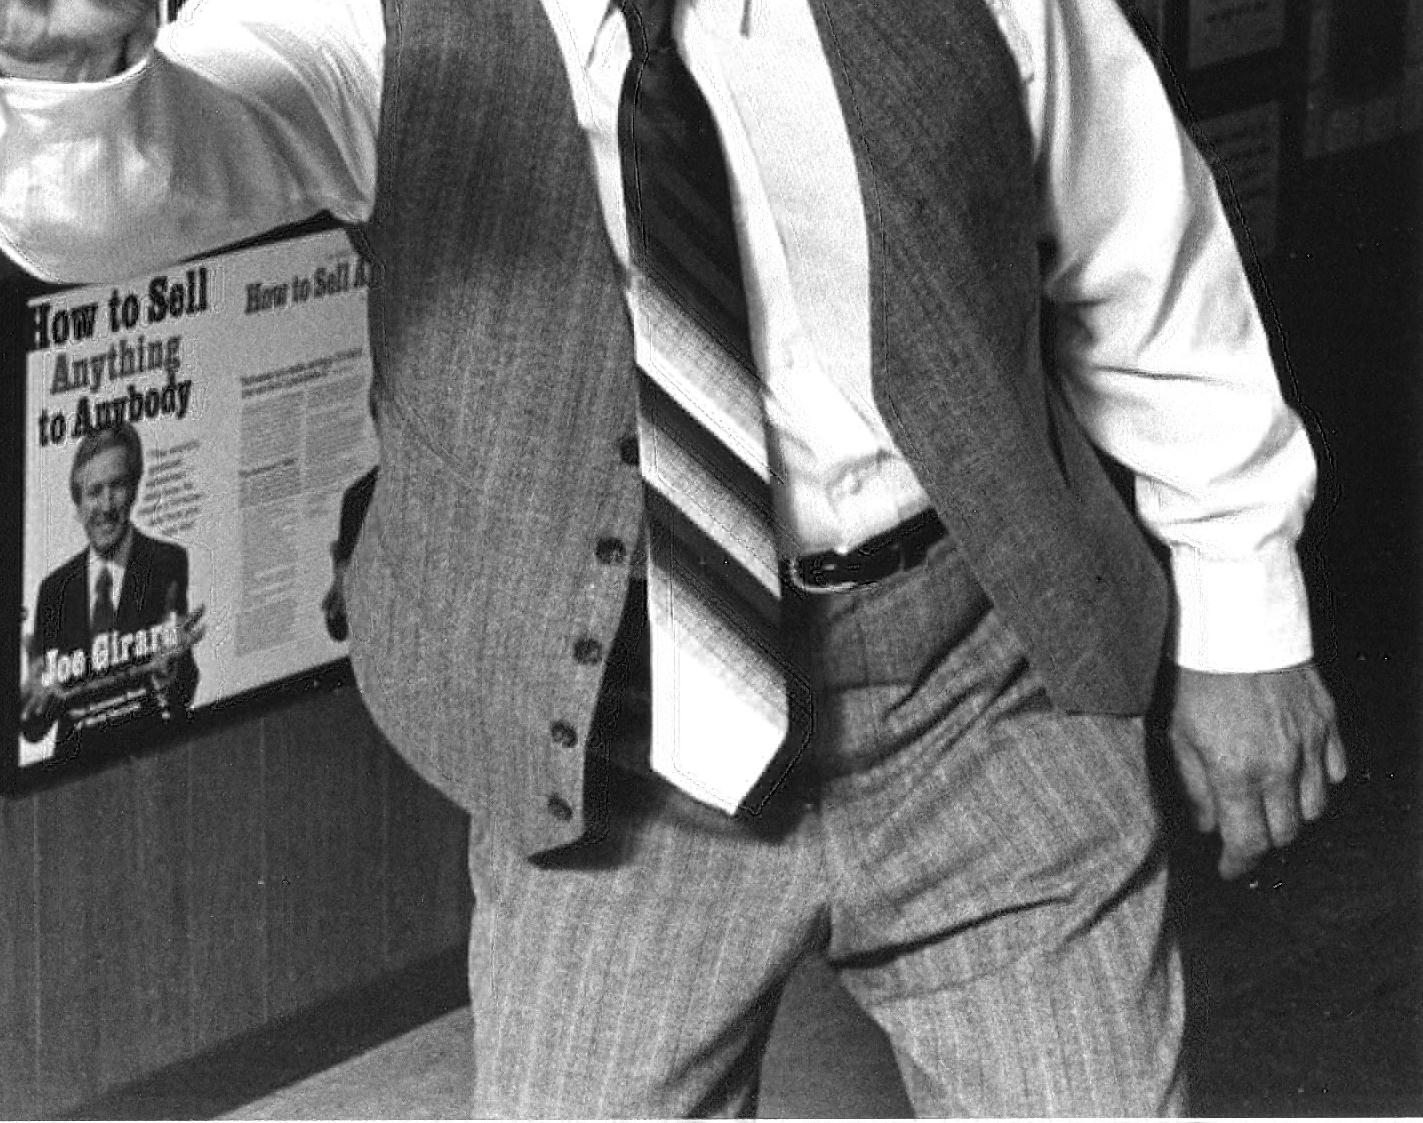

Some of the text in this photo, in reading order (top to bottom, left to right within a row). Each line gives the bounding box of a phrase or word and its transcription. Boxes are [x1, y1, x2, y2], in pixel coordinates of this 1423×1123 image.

[30, 267, 209, 351] How to Sell
[244, 282, 289, 316] How
[291, 275, 311, 304] to
[313, 262, 351, 300] Sell
[50, 334, 182, 394] Anything
[39, 374, 193, 447] to Anybody
[41, 612, 179, 687] Joe Girard
